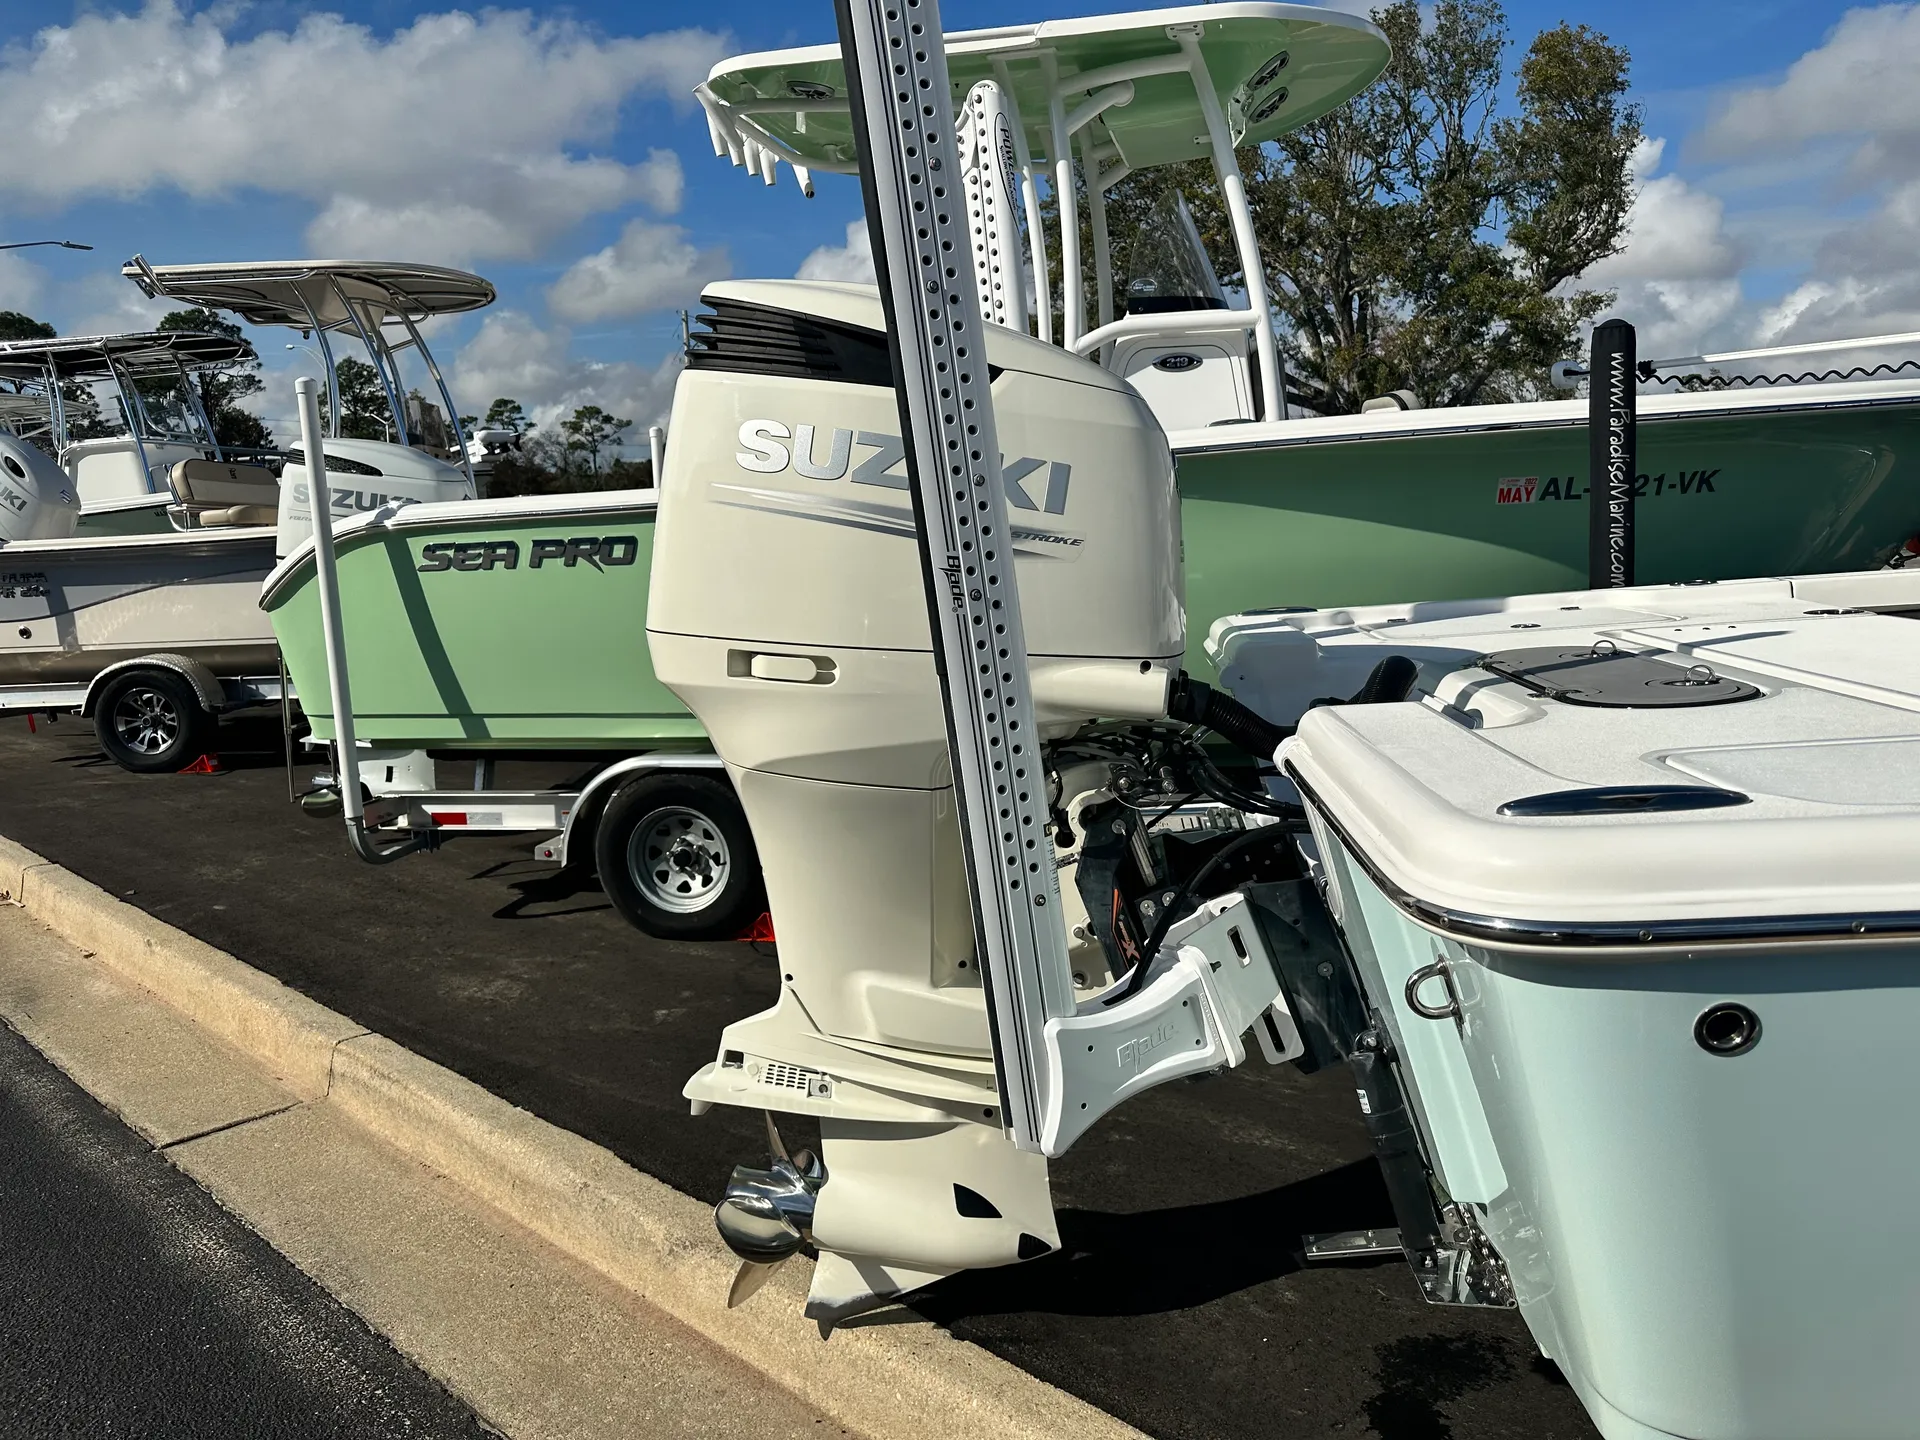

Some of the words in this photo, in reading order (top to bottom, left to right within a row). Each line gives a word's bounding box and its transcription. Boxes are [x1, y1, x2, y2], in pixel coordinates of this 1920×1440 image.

[735, 418, 1072, 516] SUZKI
[1524, 477, 1538, 485] 2022
[1608, 352, 1631, 588] www.ParadiseMarine.com
[1497, 486, 1536, 503] MAY
[1010, 530, 1085, 547] STROKE
[417, 540, 521, 573] SEA
[529, 535, 639, 574] PRO
